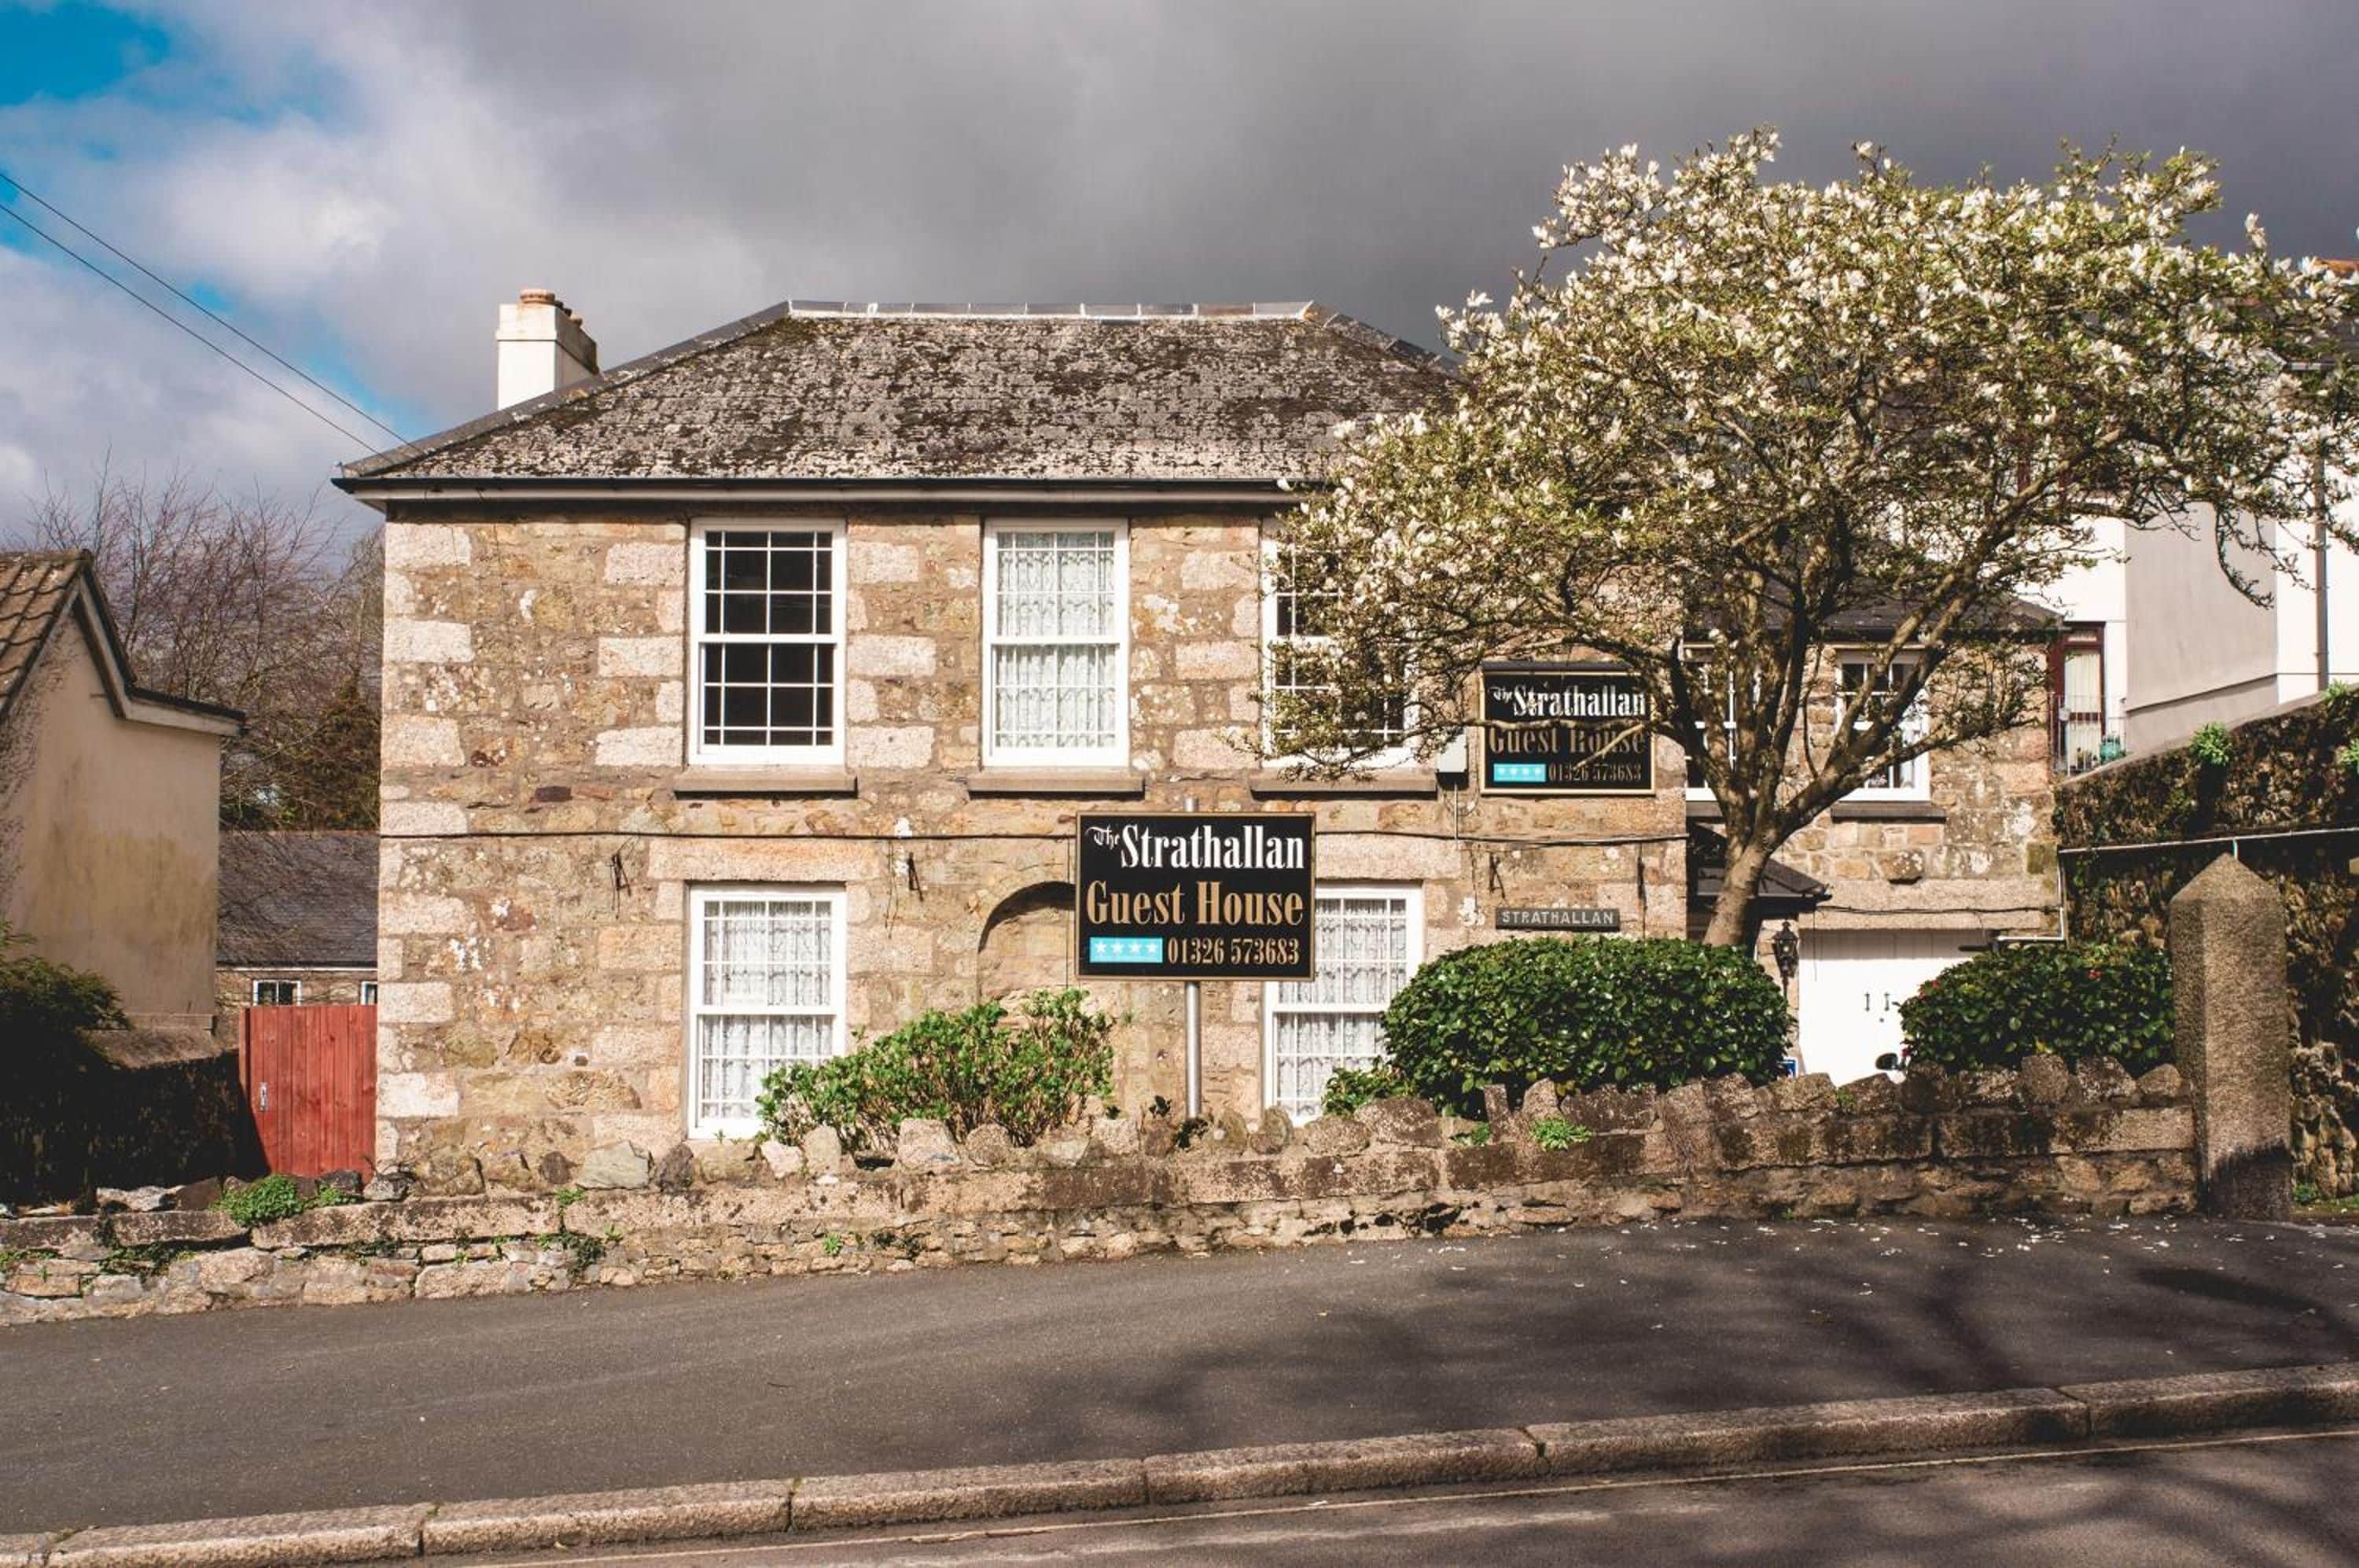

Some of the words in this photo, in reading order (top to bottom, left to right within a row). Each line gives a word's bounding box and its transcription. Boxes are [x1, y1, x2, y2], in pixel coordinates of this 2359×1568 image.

[1488, 686, 1513, 704] The
[1513, 684, 1647, 717] Strathallan
[1488, 724, 1559, 754] Guest
[1085, 826, 1121, 851] The
[1121, 823, 1305, 869] Strathallan
[1086, 880, 1186, 926] Guest
[1196, 880, 1304, 926] House
[1500, 911, 1614, 925] STRATHALLAN
[1168, 937, 1224, 965] 01326
[1231, 937, 1300, 965] 573683
